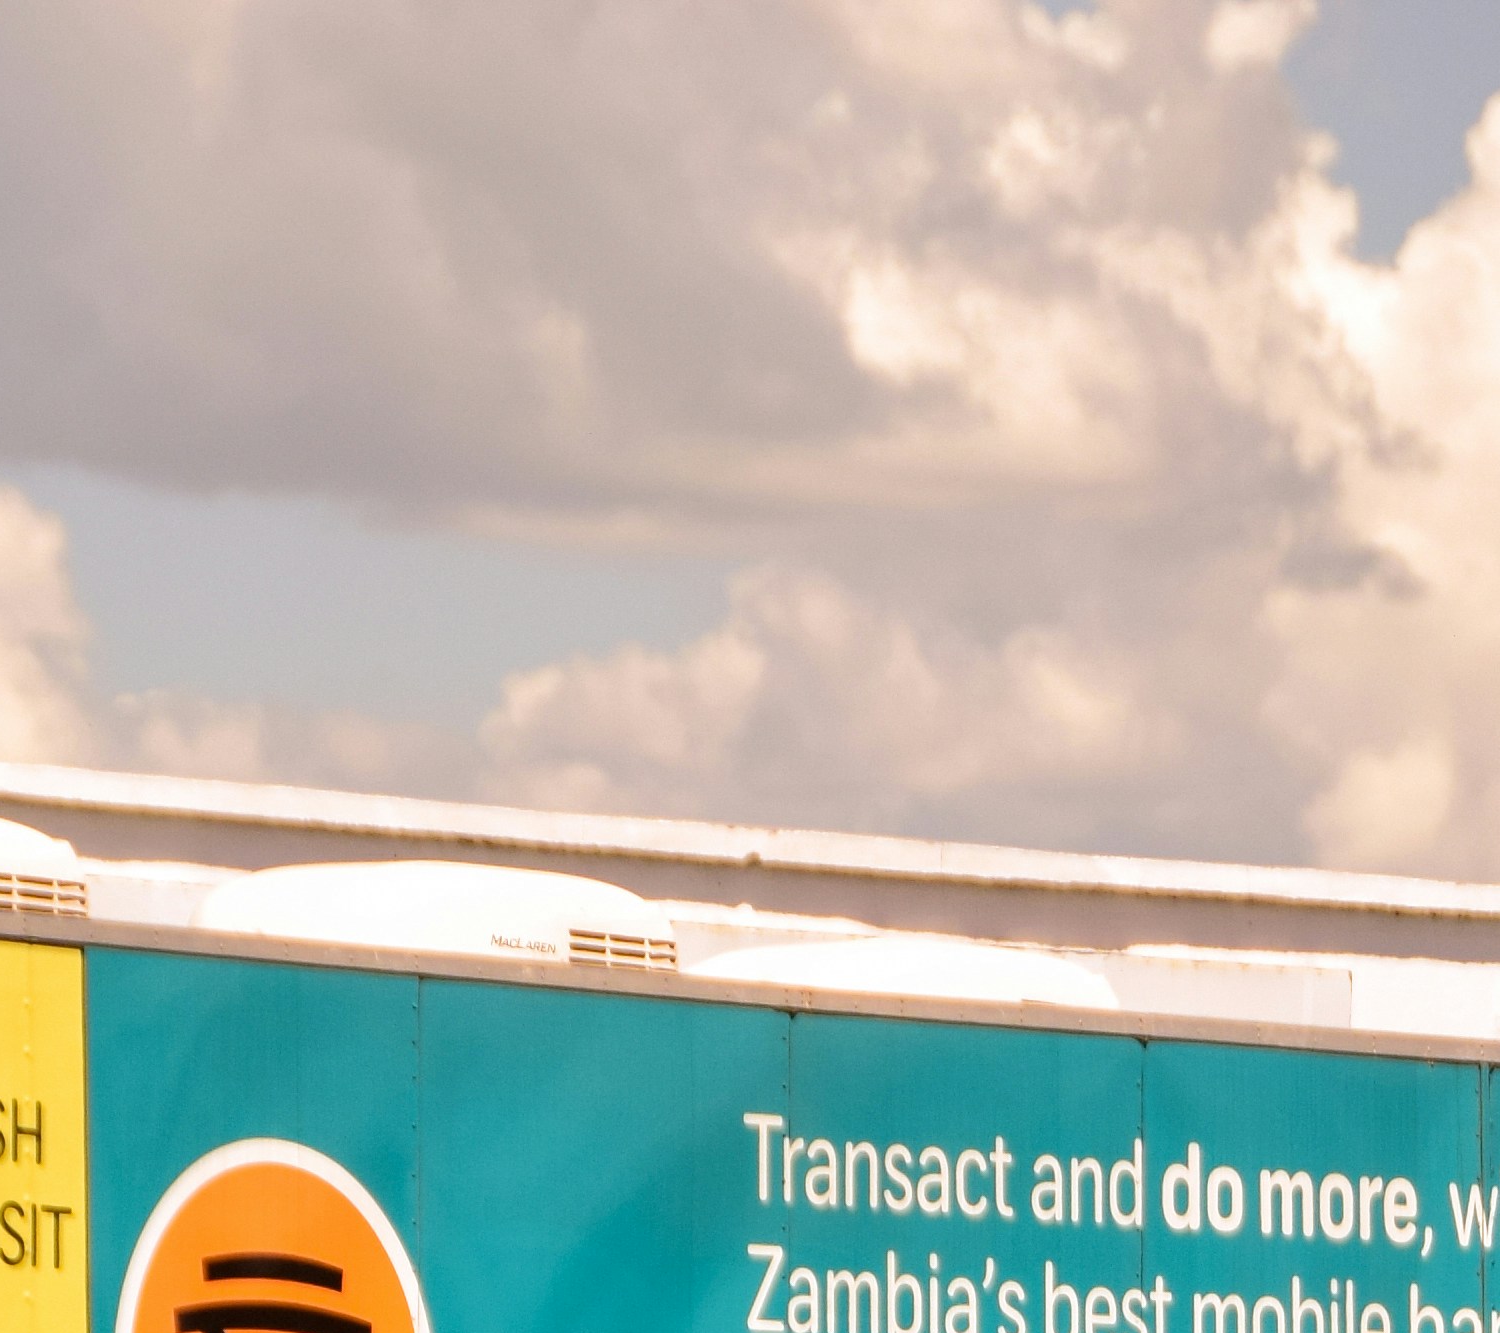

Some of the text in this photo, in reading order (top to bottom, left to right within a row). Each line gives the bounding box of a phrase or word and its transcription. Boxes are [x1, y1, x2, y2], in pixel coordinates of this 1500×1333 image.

[743, 1112, 1015, 1219] Transact
[1031, 1137, 1146, 1230] and
[1161, 1141, 1245, 1236] do
[1259, 1169, 1434, 1258] more,
